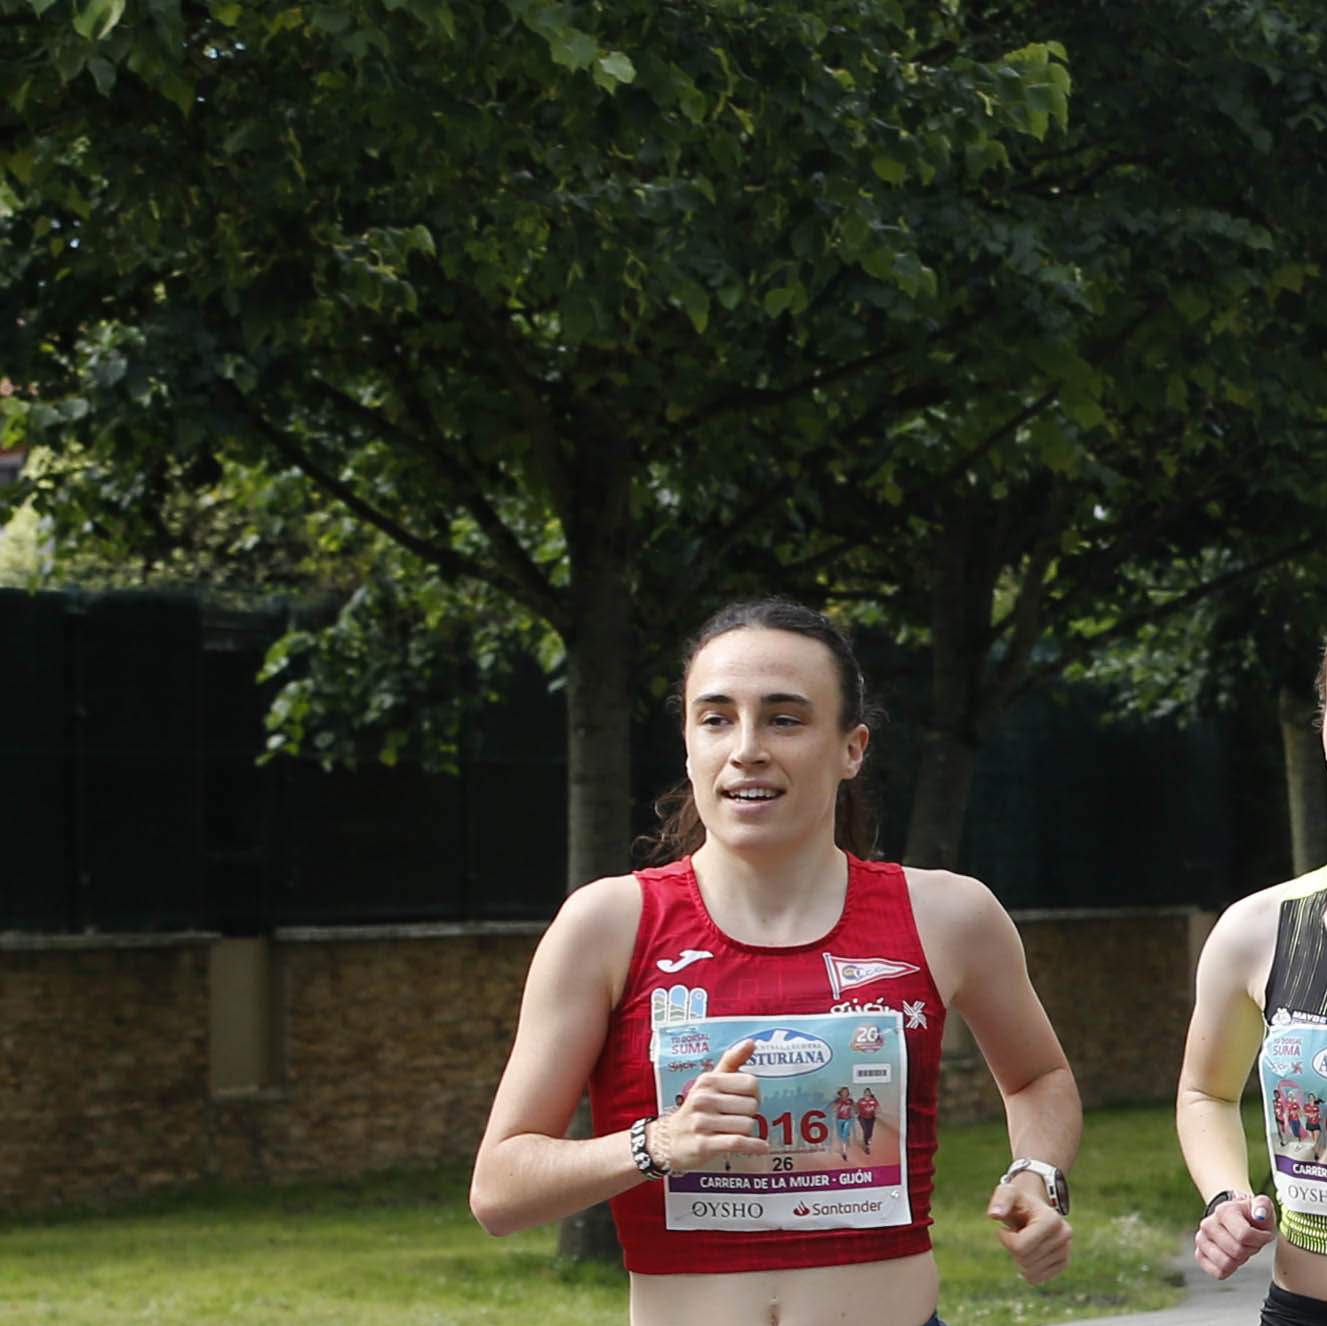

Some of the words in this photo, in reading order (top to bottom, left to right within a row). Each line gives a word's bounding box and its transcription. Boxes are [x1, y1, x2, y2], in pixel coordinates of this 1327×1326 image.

[672, 1042, 710, 1055] SUMA
[748, 1051, 825, 1066] STURIANA
[772, 1156, 794, 1172] 26
[700, 1176, 751, 1189] CARRERA
[753, 1177, 769, 1190] DE
[771, 1177, 787, 1189] LA
[789, 1174, 830, 1188] MUJER
[839, 1170, 872, 1186] GIJÓN
[692, 1201, 764, 1219] OYSHO
[812, 1201, 883, 1217] Santander
